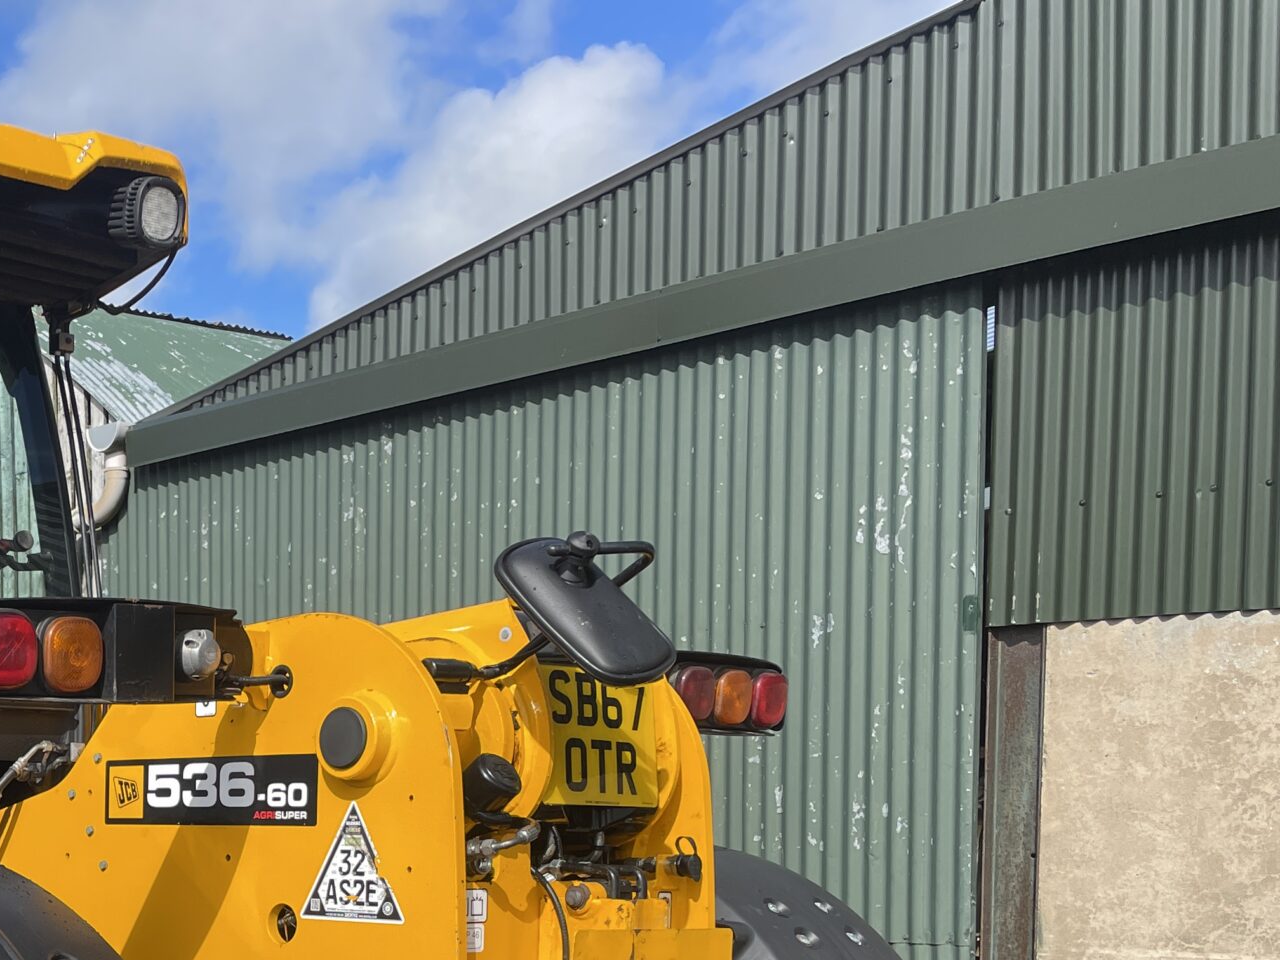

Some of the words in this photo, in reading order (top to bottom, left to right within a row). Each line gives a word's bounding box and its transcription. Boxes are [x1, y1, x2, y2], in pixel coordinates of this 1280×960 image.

[549, 669, 646, 731] SB67
[116, 778, 139, 806] JCB
[146, 761, 308, 808] 536-60
[565, 737, 638, 796] OTR
[253, 811, 307, 820] AGRISUPER
[338, 849, 366, 876] 32
[325, 878, 379, 907] AS2E
